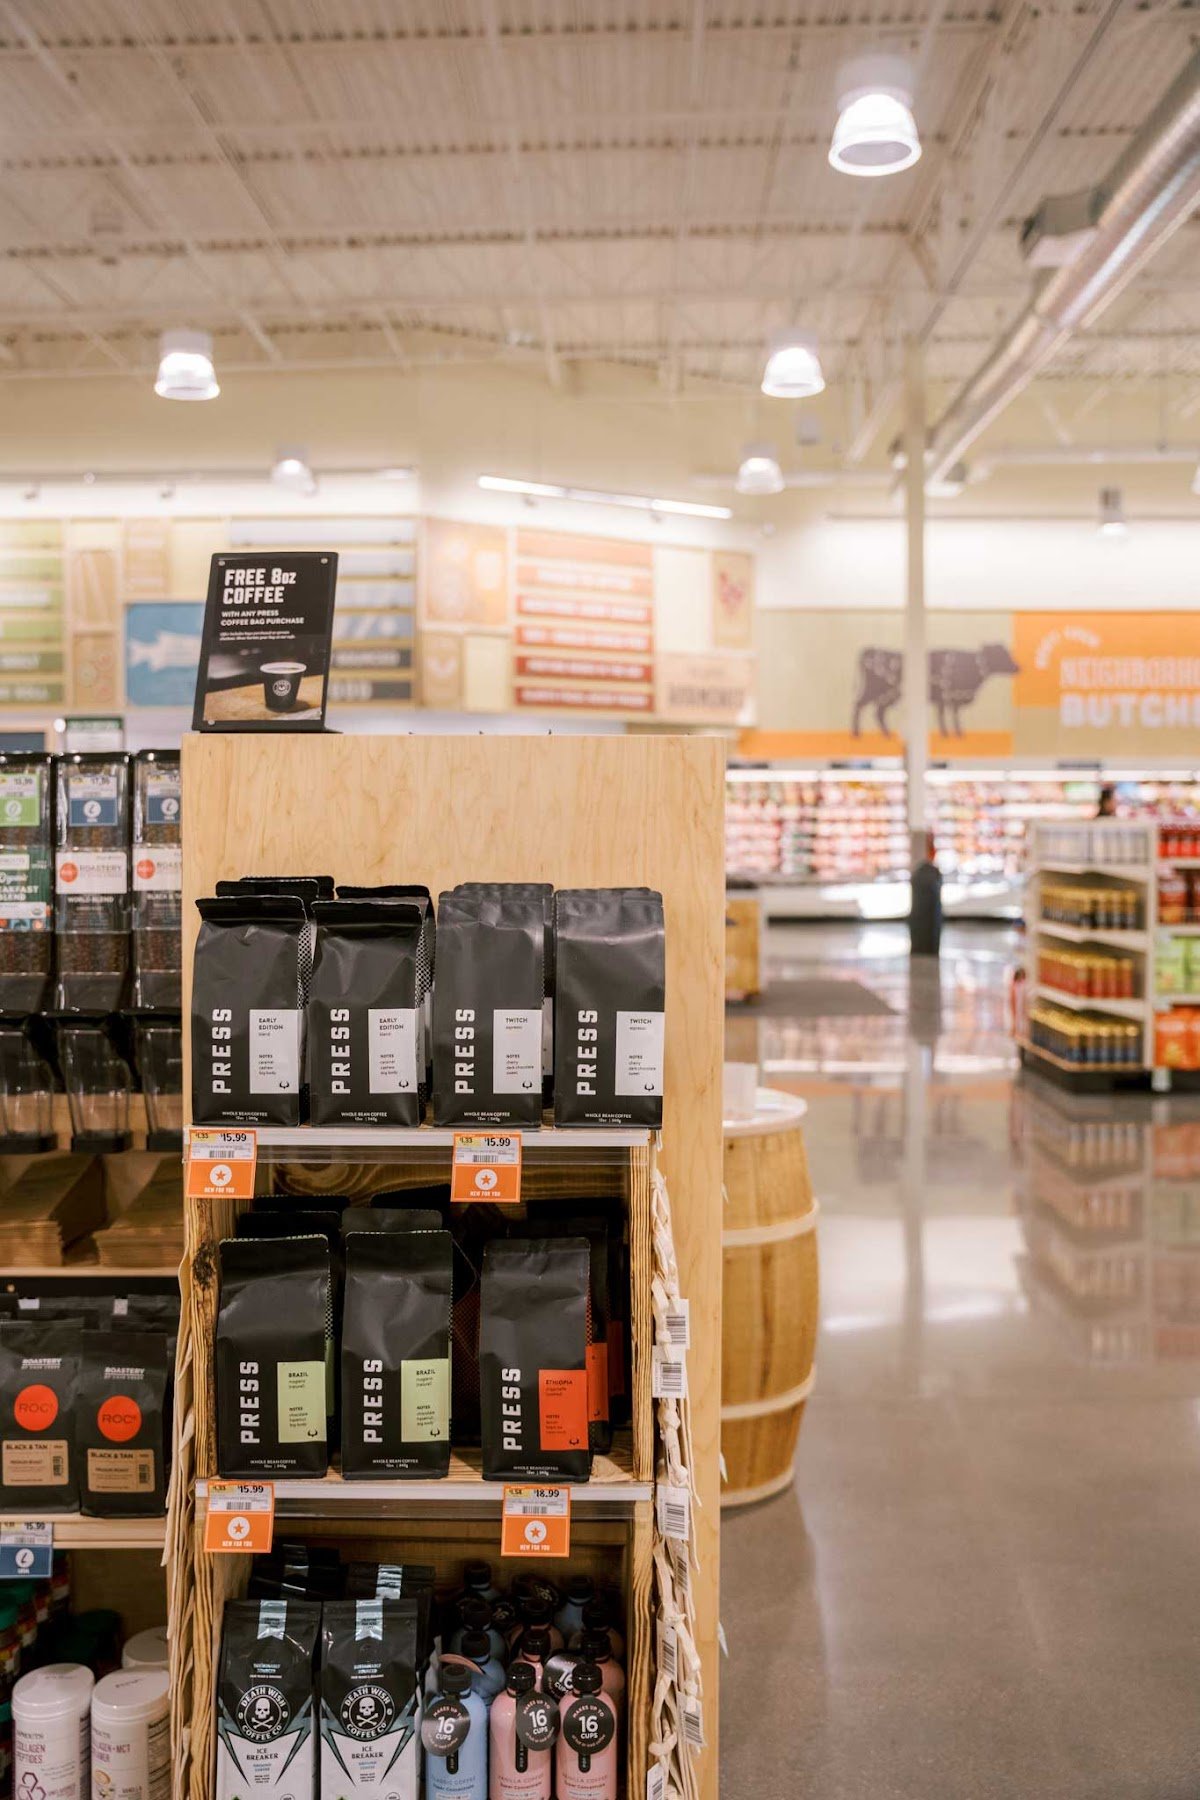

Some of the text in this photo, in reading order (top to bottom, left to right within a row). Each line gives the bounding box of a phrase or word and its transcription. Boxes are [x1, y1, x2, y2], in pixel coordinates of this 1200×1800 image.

[225, 568, 266, 586] FREE
[223, 586, 285, 604] COFFEE
[0, 885, 39, 894] AKFAST
[212, 1008, 232, 1094] PRESS
[330, 1008, 351, 1094] PRESS
[455, 1009, 475, 1094] PRESS
[576, 1010, 598, 1096] PRESS
[239, 1361, 260, 1444] PRESS
[363, 1359, 383, 1443] PRESS
[502, 1368, 522, 1451] PRESS
[241, 1687, 287, 1707] DEATH WISH
[344, 1687, 391, 1706] DEATH WISH
[433, 1706, 450, 1717] MAKES
[523, 1700, 536, 1715] MAKES
[544, 1701, 551, 1710] TO
[572, 1705, 589, 1718] MAKES
[598, 1708, 605, 1717] TO
[437, 1716, 457, 1734] 16
[529, 1709, 548, 1728] 16
[578, 1715, 599, 1732] 16
[242, 1724, 271, 1740] COFFEE
[346, 1723, 375, 1738] COFFEE
[435, 1733, 452, 1741] CUPS
[533, 1726, 548, 1735] CUPS
